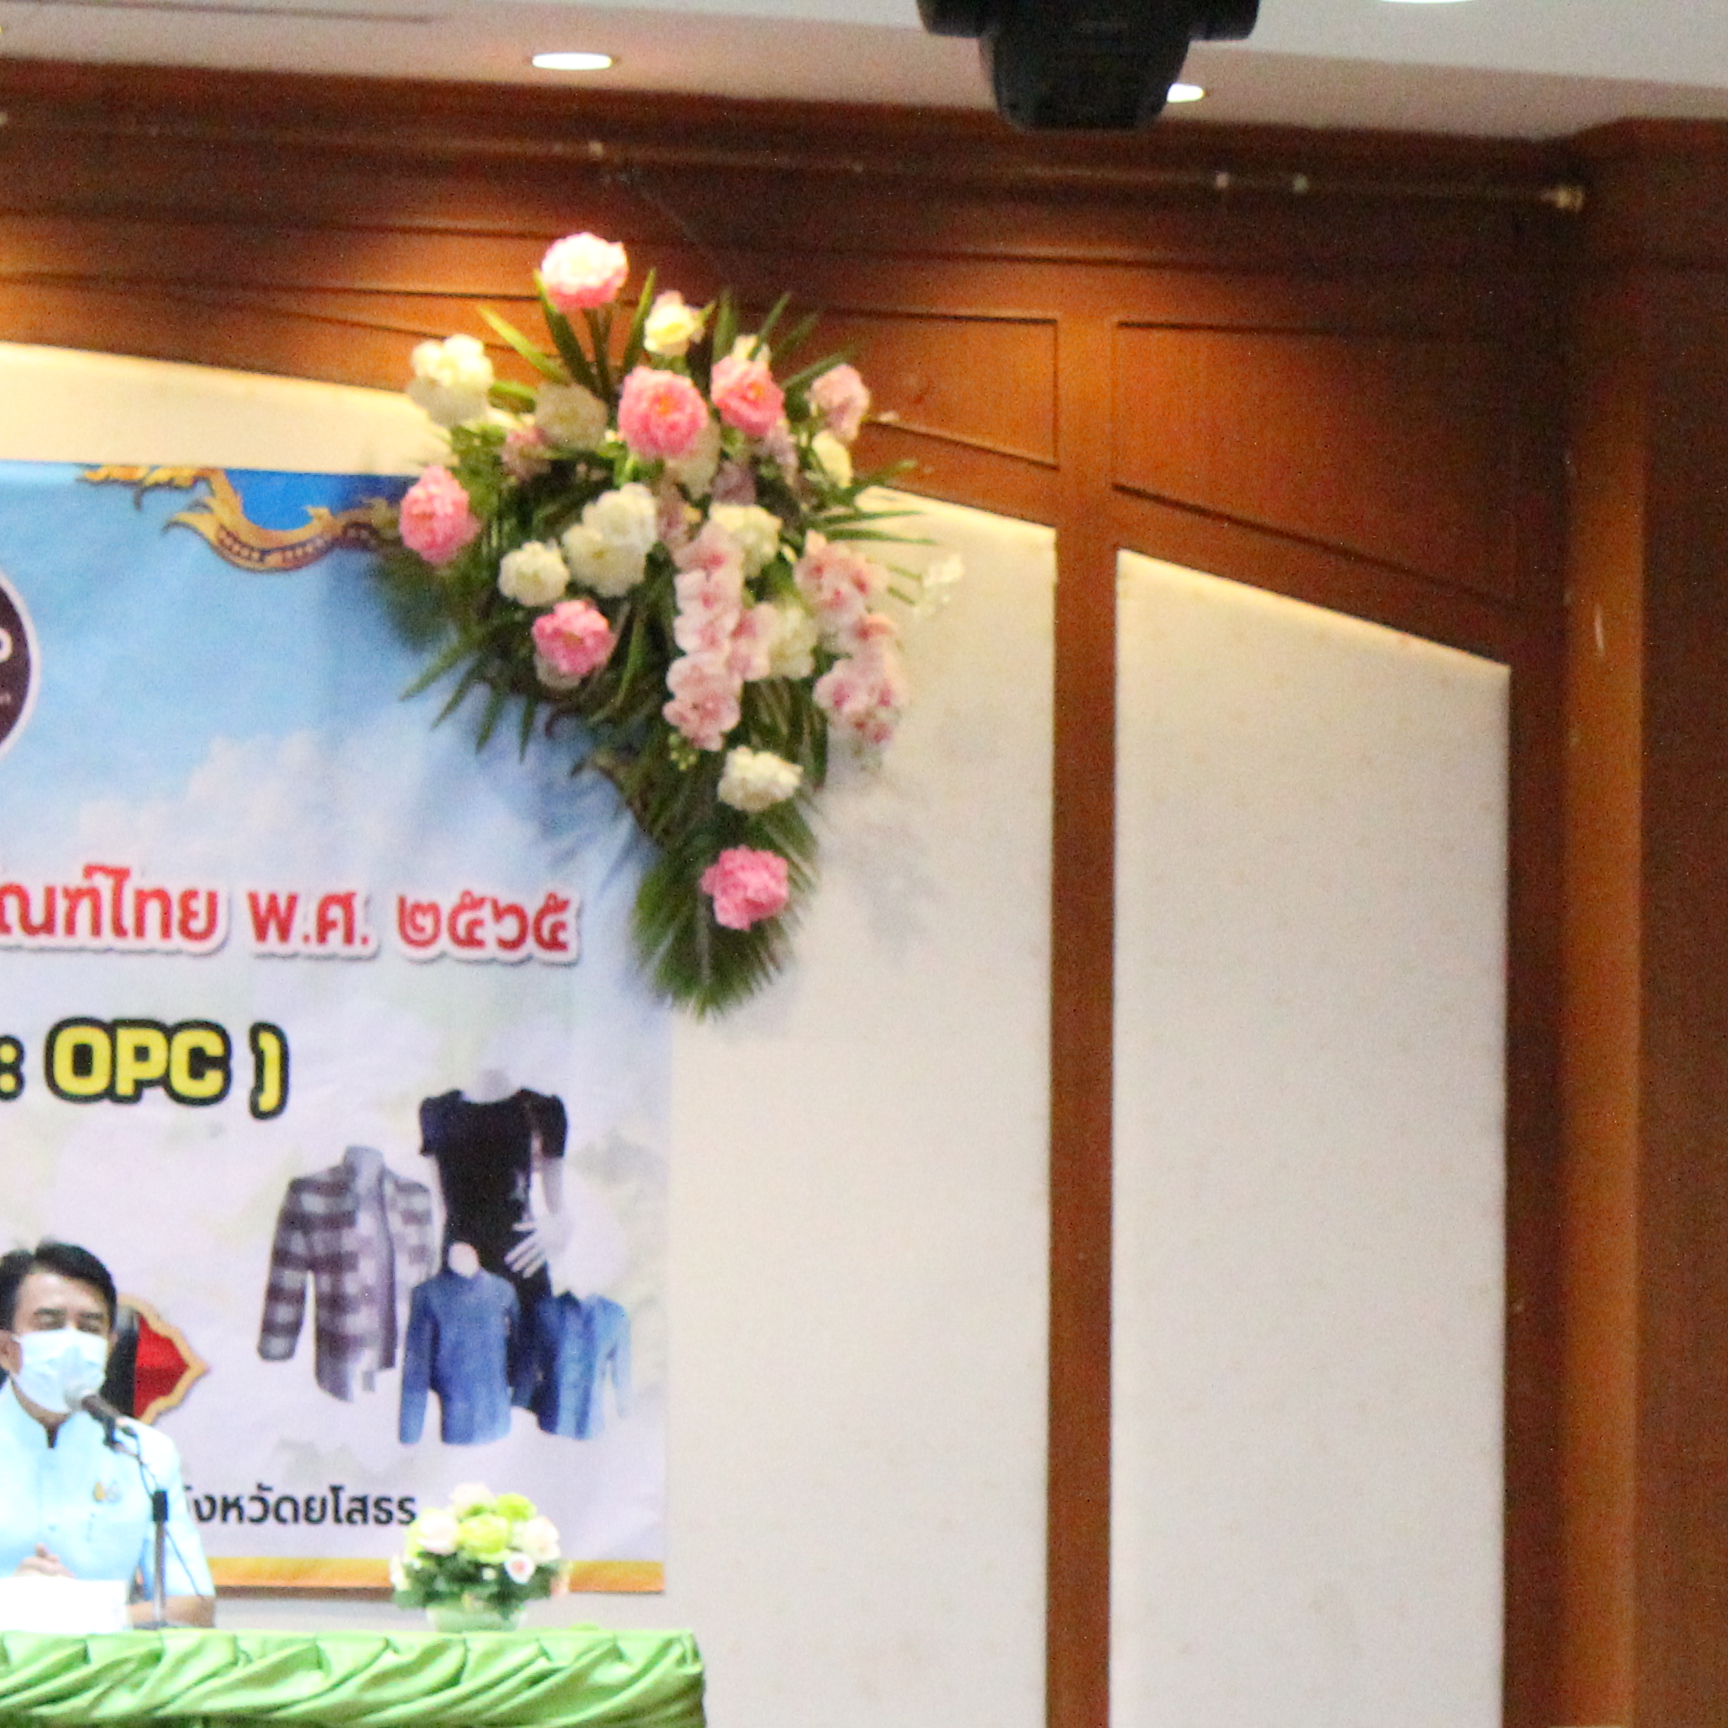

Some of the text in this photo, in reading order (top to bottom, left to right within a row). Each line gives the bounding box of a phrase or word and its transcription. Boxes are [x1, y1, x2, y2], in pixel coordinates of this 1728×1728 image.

[248, 889, 369, 948] พ.ศ.
[398, 890, 572, 953] ๒๕๖๕
[49, 1021, 228, 1102] OPC
[183, 1479, 417, 1526] งหวัดยโสธร
